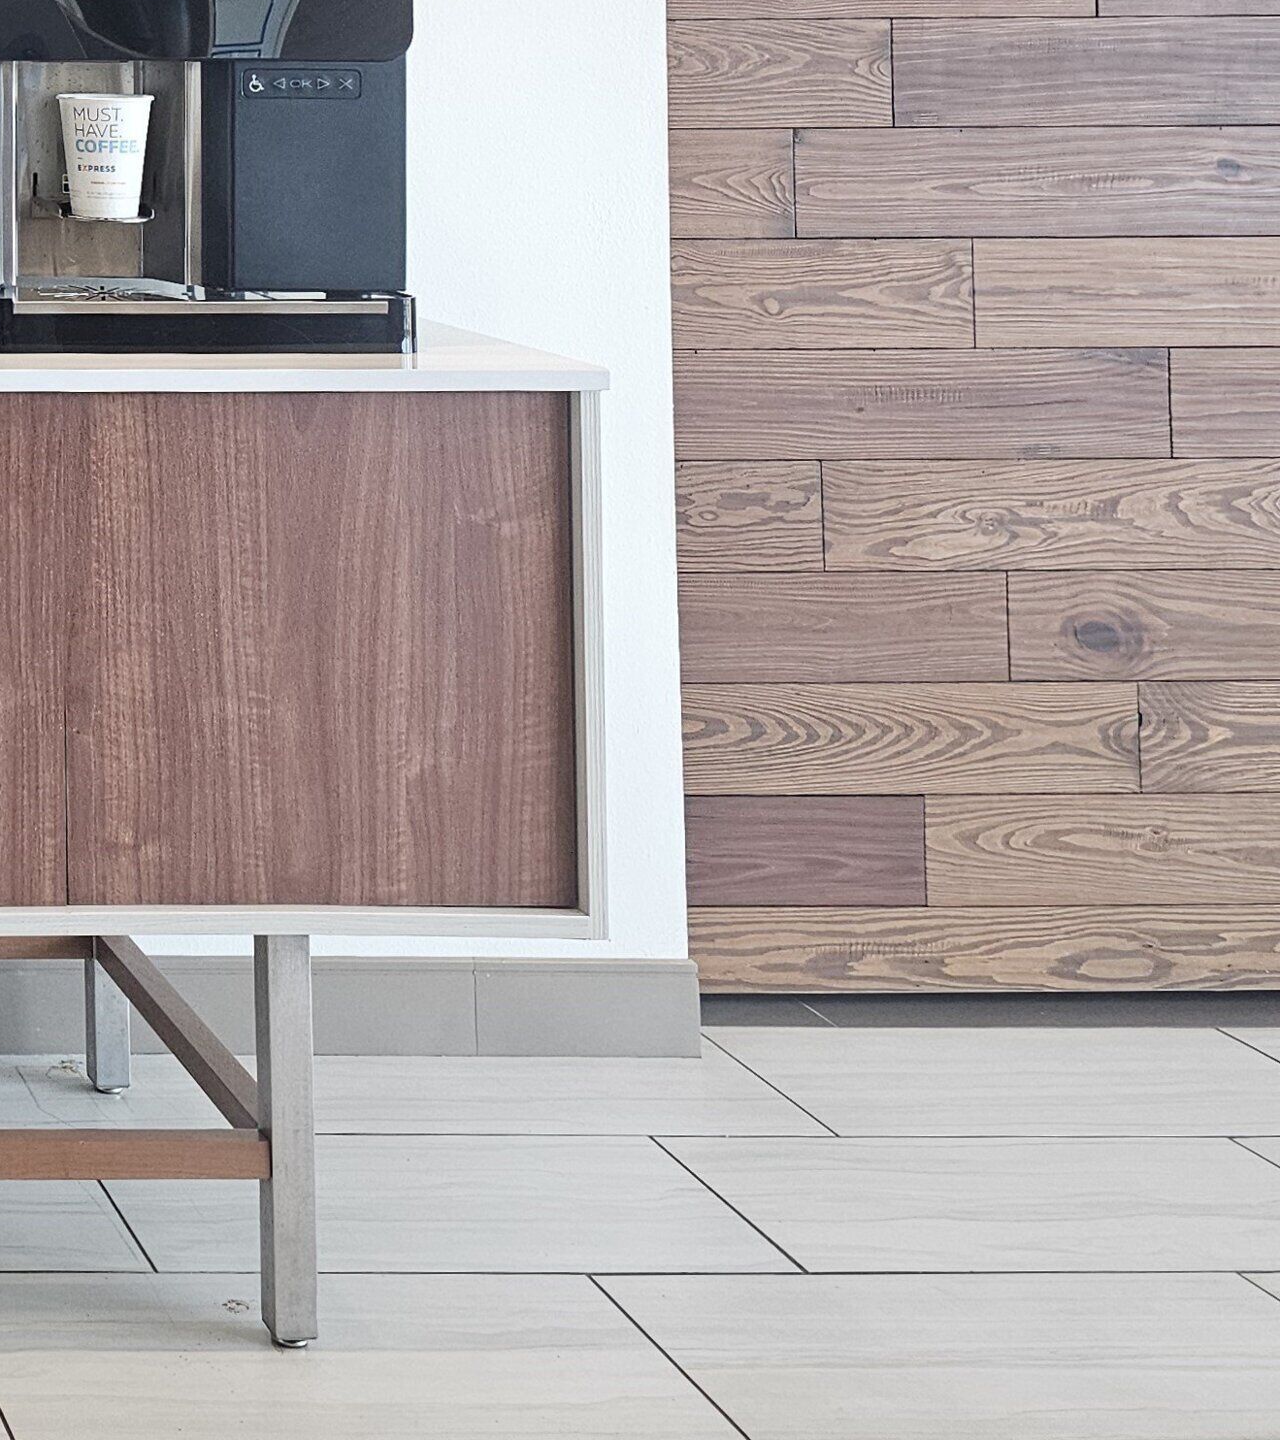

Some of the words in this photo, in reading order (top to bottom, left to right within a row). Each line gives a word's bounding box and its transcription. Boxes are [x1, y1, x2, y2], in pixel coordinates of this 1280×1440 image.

[289, 79, 313, 88] OK
[73, 107, 124, 122] MUST.
[74, 123, 122, 138] HAVE.
[75, 139, 140, 154] COFFEE.
[78, 164, 116, 173] EXPRESS
